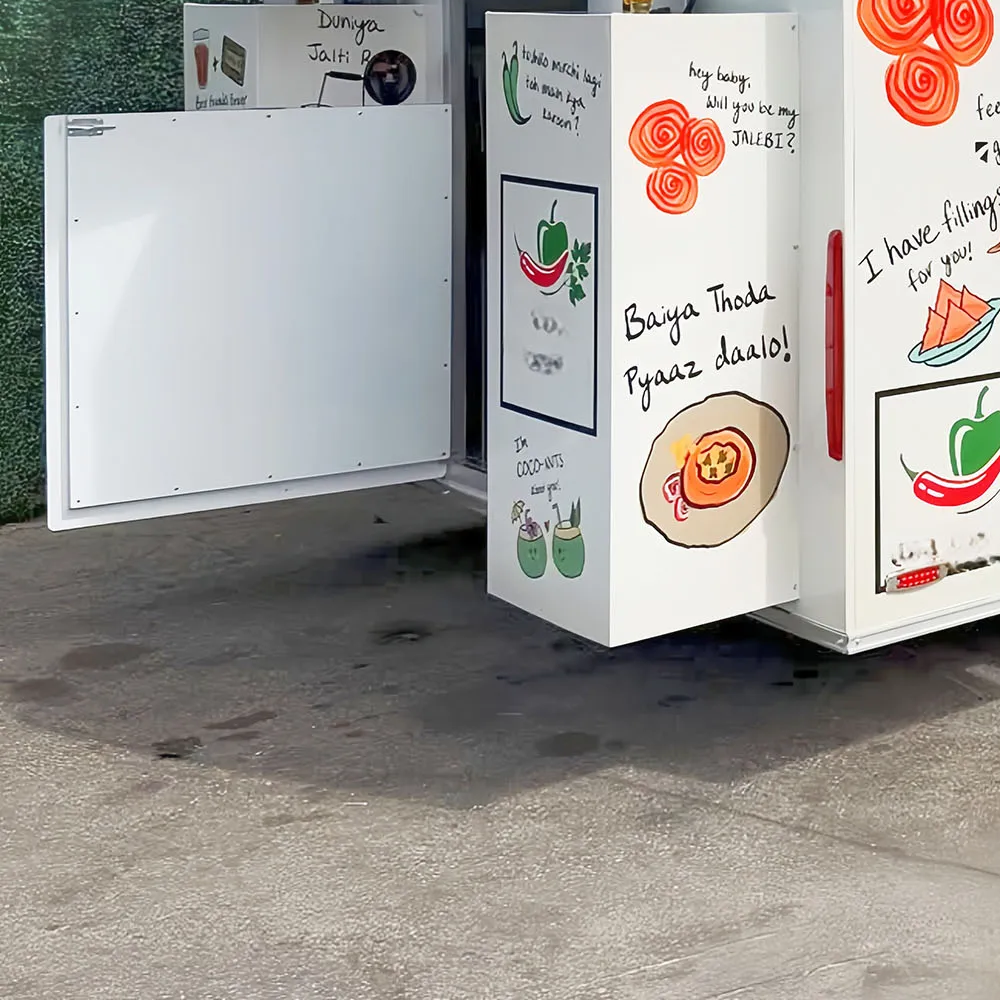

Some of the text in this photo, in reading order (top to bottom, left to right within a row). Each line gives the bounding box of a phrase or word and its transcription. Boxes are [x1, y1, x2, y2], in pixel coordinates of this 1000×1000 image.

[317, 8, 385, 45] Duniya
[307, 42, 350, 64] Jalti
[688, 60, 751, 94] hey baby,
[732, 101, 755, 124] you
[759, 100, 775, 115] be
[777, 105, 800, 130] my
[732, 129, 796, 154] JALEBI?
[858, 249, 884, 285] I
[884, 224, 941, 266] have
[909, 241, 973, 292] for you!
[624, 281, 776, 346] Baiya Thoda
[623, 360, 703, 412] Pyaaz
[715, 325, 791, 370] daalo!
